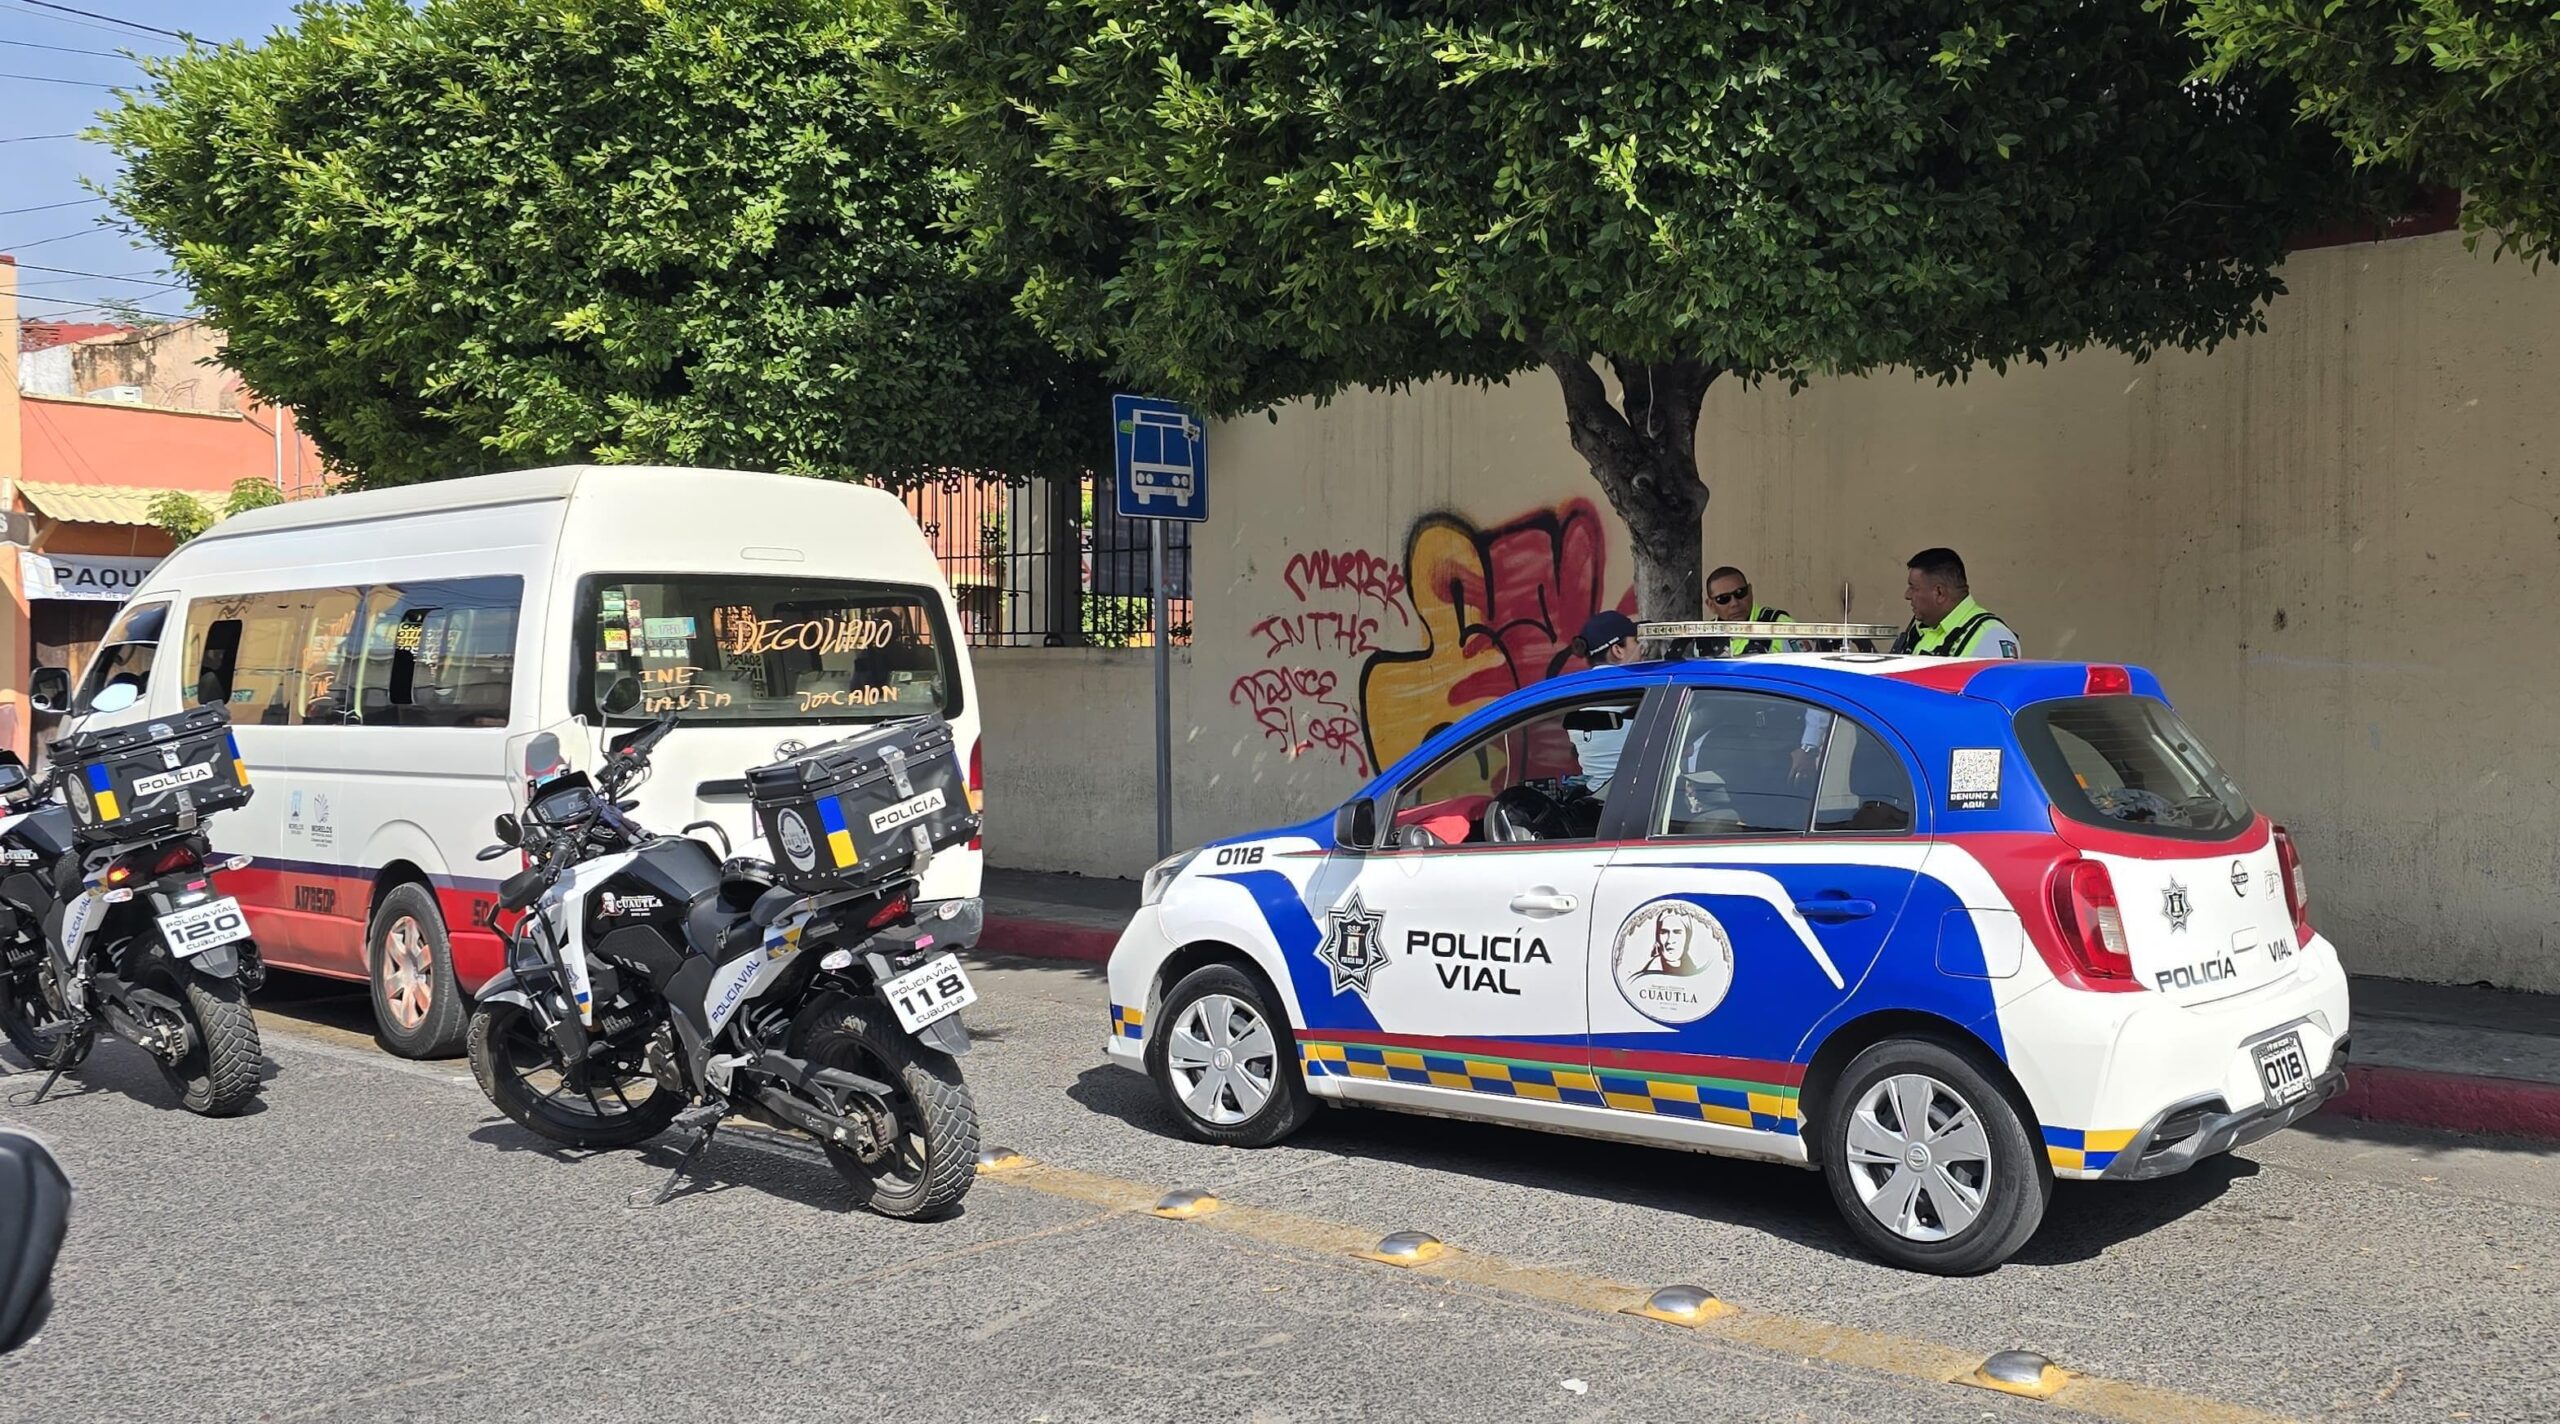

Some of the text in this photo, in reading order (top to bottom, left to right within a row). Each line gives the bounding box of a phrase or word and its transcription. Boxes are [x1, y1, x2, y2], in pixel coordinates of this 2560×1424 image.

[53, 567, 151, 588] PAQU
[1284, 549, 1408, 626] MURDER
[1251, 612, 1381, 657] IN THE
[638, 667, 704, 684] INE
[875, 796, 941, 829] POLICIA
[1216, 846, 1264, 866] 0118
[616, 898, 664, 908] CUAUTLA
[171, 913, 241, 944] 120
[1407, 927, 1552, 964] POLICÍA
[1435, 963, 1521, 995] VIAL
[2155, 937, 2292, 992] POLICÍA VIAL
[899, 973, 965, 1016] 118
[1639, 989, 1698, 1004] CUAUTLA
[2264, 1051, 2304, 1090] 0118
